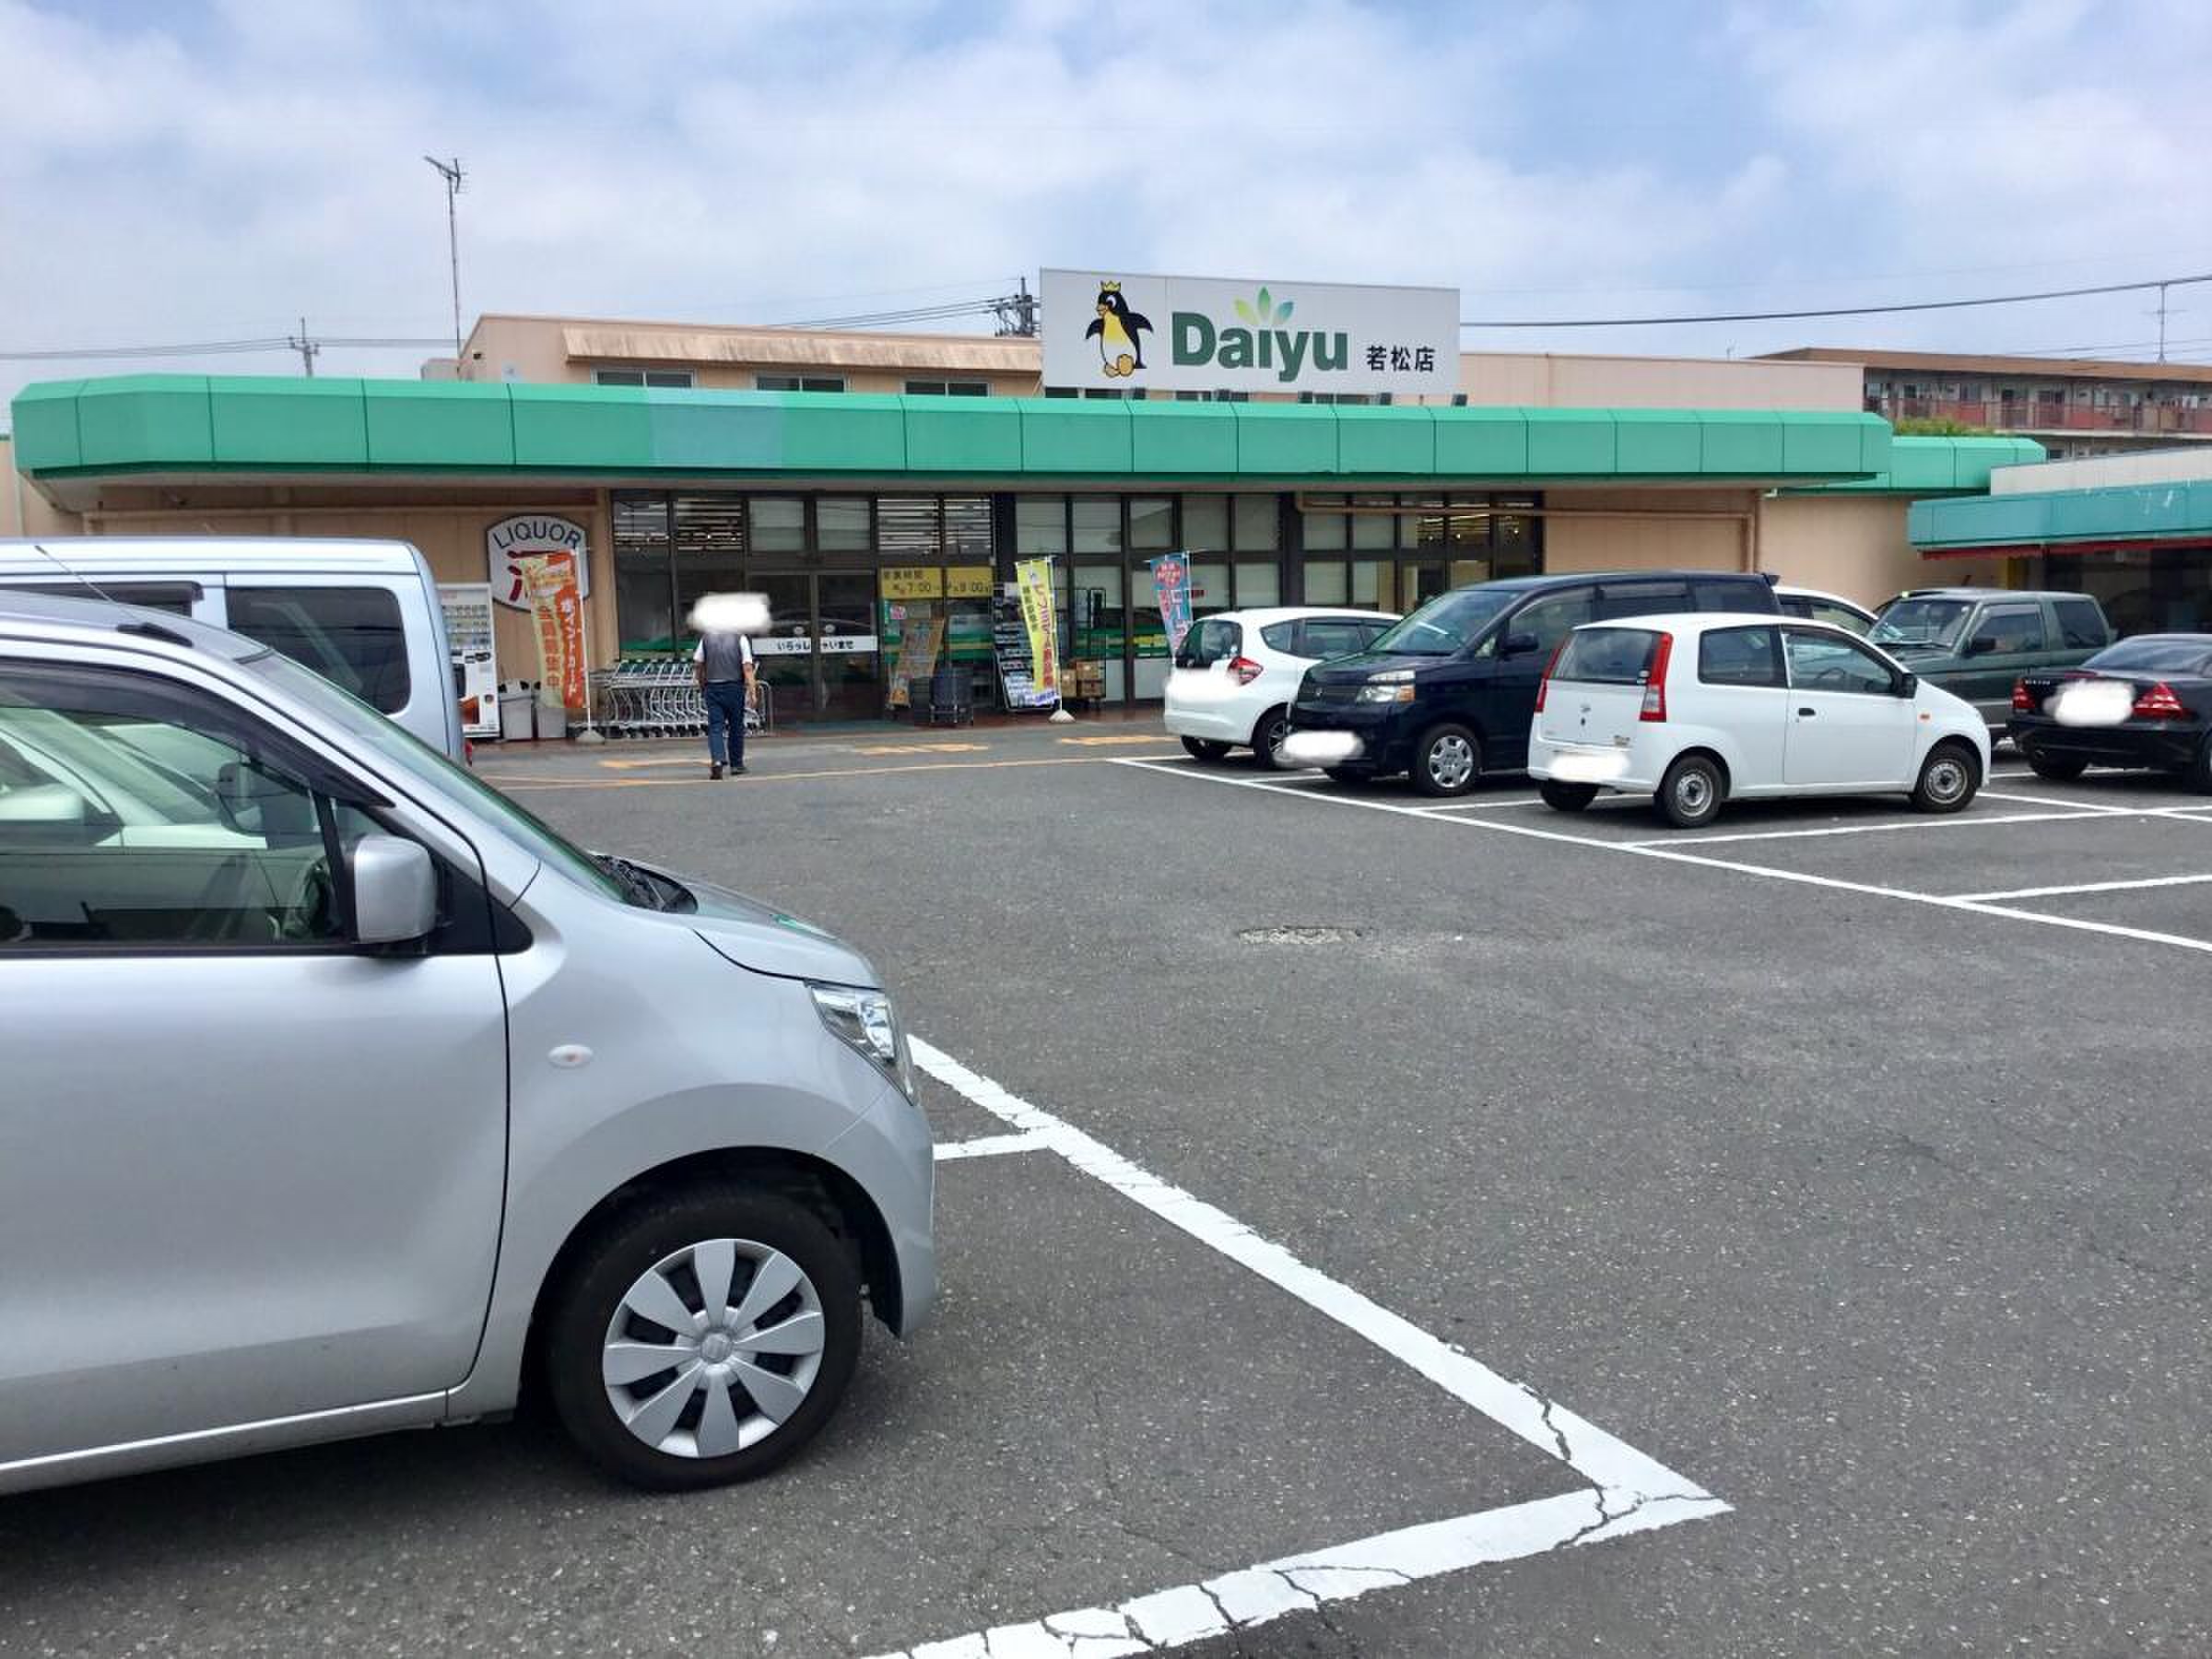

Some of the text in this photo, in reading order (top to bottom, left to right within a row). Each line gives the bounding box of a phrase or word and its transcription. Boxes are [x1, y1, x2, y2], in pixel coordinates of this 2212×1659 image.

[1171, 312, 1347, 382] Daiyu
[1365, 345, 1437, 373] 若松店
[492, 521, 582, 550] LIQUOR
